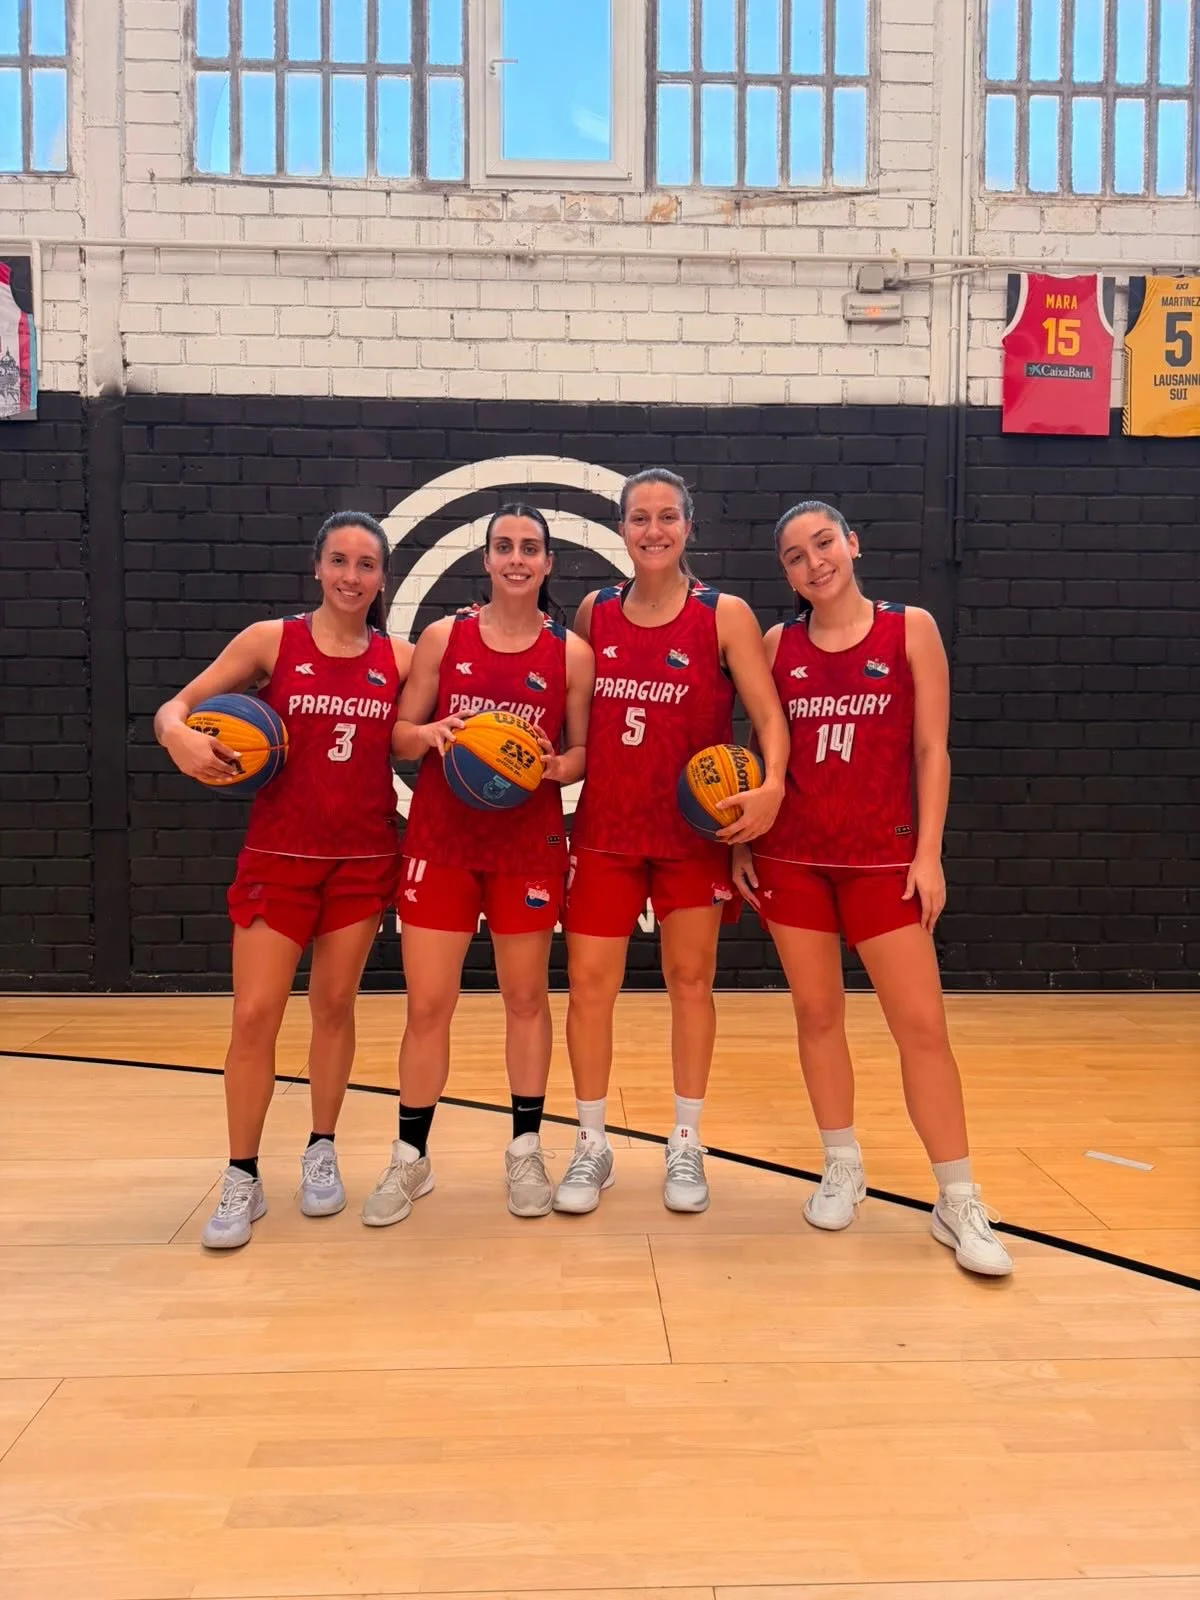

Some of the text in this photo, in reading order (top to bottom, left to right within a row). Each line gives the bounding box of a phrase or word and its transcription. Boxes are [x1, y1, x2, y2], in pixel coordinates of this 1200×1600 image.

[1046, 294, 1078, 310] MARA
[1161, 296, 1200, 307] MARTINEZ
[1042, 317, 1081, 356] 15
[1164, 312, 1193, 367] 5
[1041, 364, 1092, 379] CaixaBank
[1153, 374, 1200, 386] LAUSANN
[1169, 388, 1188, 401] SUI
[593, 677, 690, 705] PARAGUAY
[288, 694, 392, 721] PARAGUAY
[788, 693, 892, 721] PARAGUAY
[621, 706, 647, 747] 5
[327, 722, 357, 762] 3
[815, 722, 856, 764] 14
